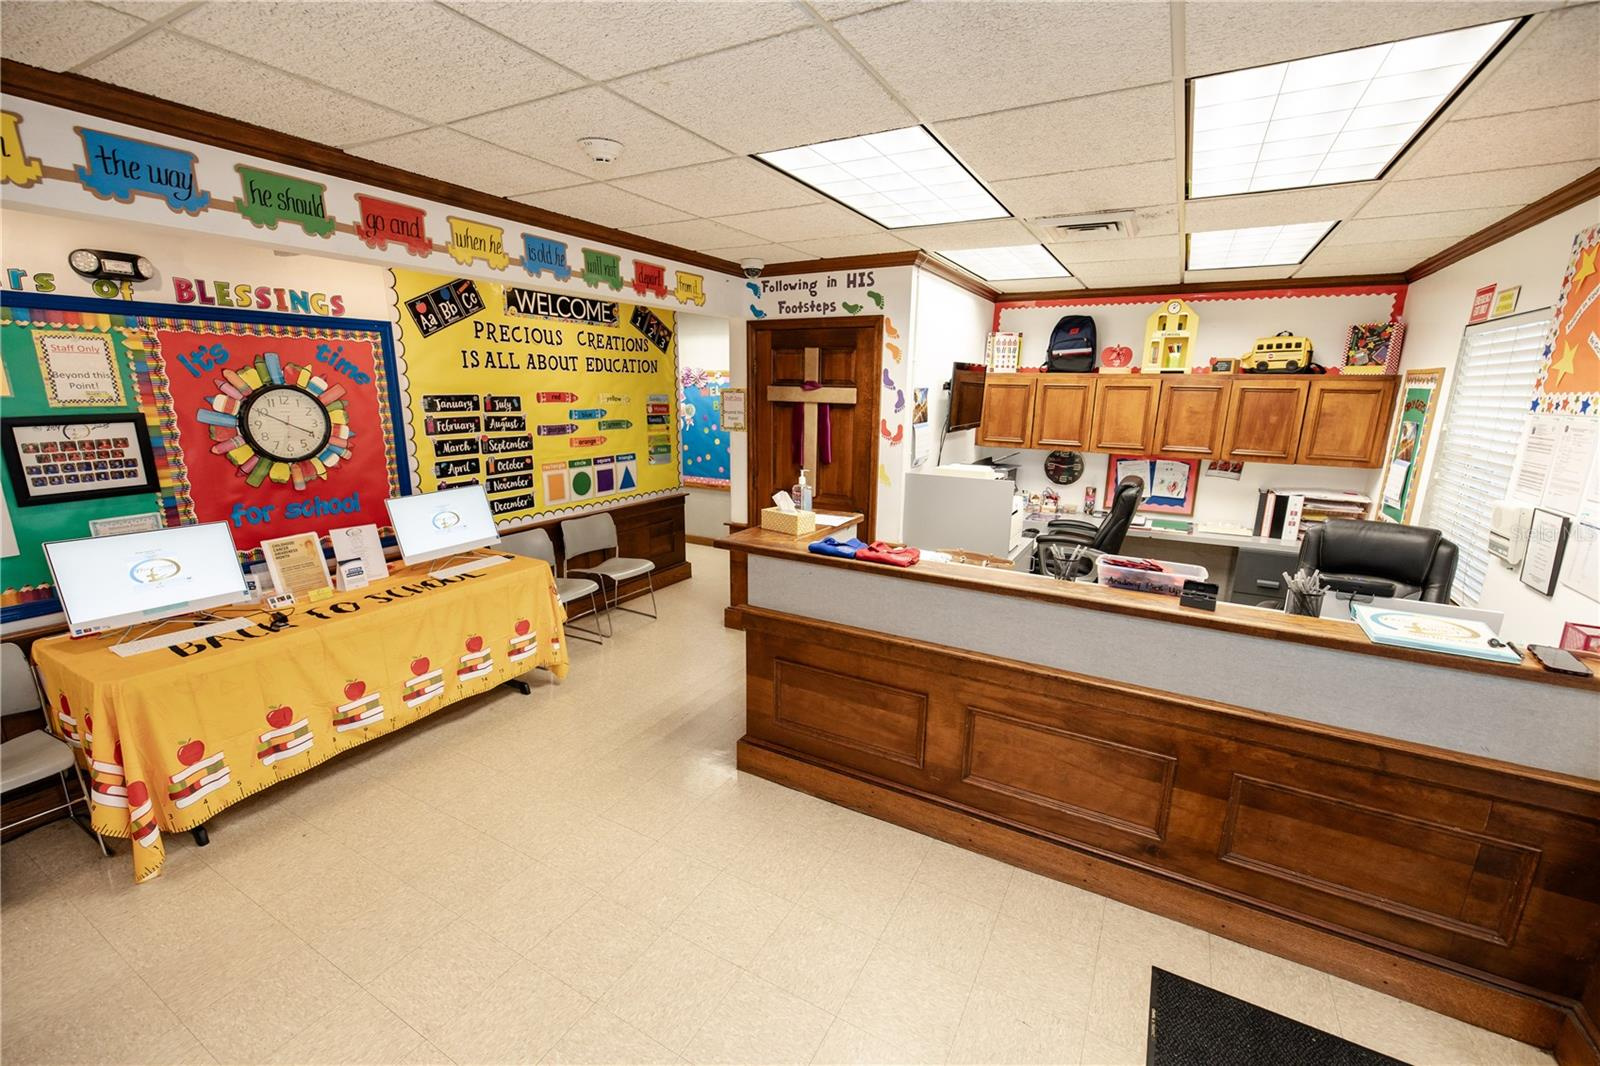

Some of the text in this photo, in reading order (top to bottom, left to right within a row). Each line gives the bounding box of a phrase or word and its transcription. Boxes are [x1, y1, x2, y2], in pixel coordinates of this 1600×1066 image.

[96, 145, 192, 200] the way
[250, 180, 325, 219] he should
[366, 212, 421, 239] go and
[455, 232, 501, 254] when he
[528, 244, 565, 266] is old he
[588, 256, 616, 278] will not
[762, 272, 874, 297] Following in HIS
[0, 268, 56, 292] rs
[172, 276, 346, 316] BLESSINGS
[461, 291, 478, 310] Cc
[514, 289, 612, 322] WELCOME
[778, 300, 836, 315] Footsteps
[438, 302, 458, 319] Bb
[422, 313, 438, 331] Aa
[636, 316, 642, 326] 1
[474, 321, 649, 352] PRECIOUS CREATIONS
[660, 338, 666, 348] 3
[51, 344, 100, 354] Staff Only
[178, 343, 230, 377] It's
[315, 344, 370, 385] time
[462, 350, 658, 374] IS ALL ABOUT EDUCATION
[52, 371, 90, 380] Beyond
[69, 382, 98, 390] Point!
[267, 399, 275, 407] 11
[279, 396, 288, 405] 12
[434, 398, 474, 412] January
[494, 400, 512, 412] July
[256, 408, 268, 416] 10
[305, 407, 312, 416] 2
[254, 420, 262, 430] 9
[437, 419, 476, 433] February
[490, 418, 518, 432] August
[261, 432, 269, 441] 8
[274, 440, 279, 450] 7
[287, 444, 294, 452] 6
[301, 440, 307, 448] 5
[443, 441, 472, 453] March
[488, 438, 530, 453] September
[448, 462, 471, 477] April
[497, 459, 525, 471] October
[494, 478, 529, 491] November
[231, 493, 360, 527] for school
[494, 498, 529, 512] December
[1168, 587, 1180, 596] Up
[168, 621, 299, 657] BACK
[305, 602, 360, 619] TO
[364, 573, 487, 603] SCHOOL
